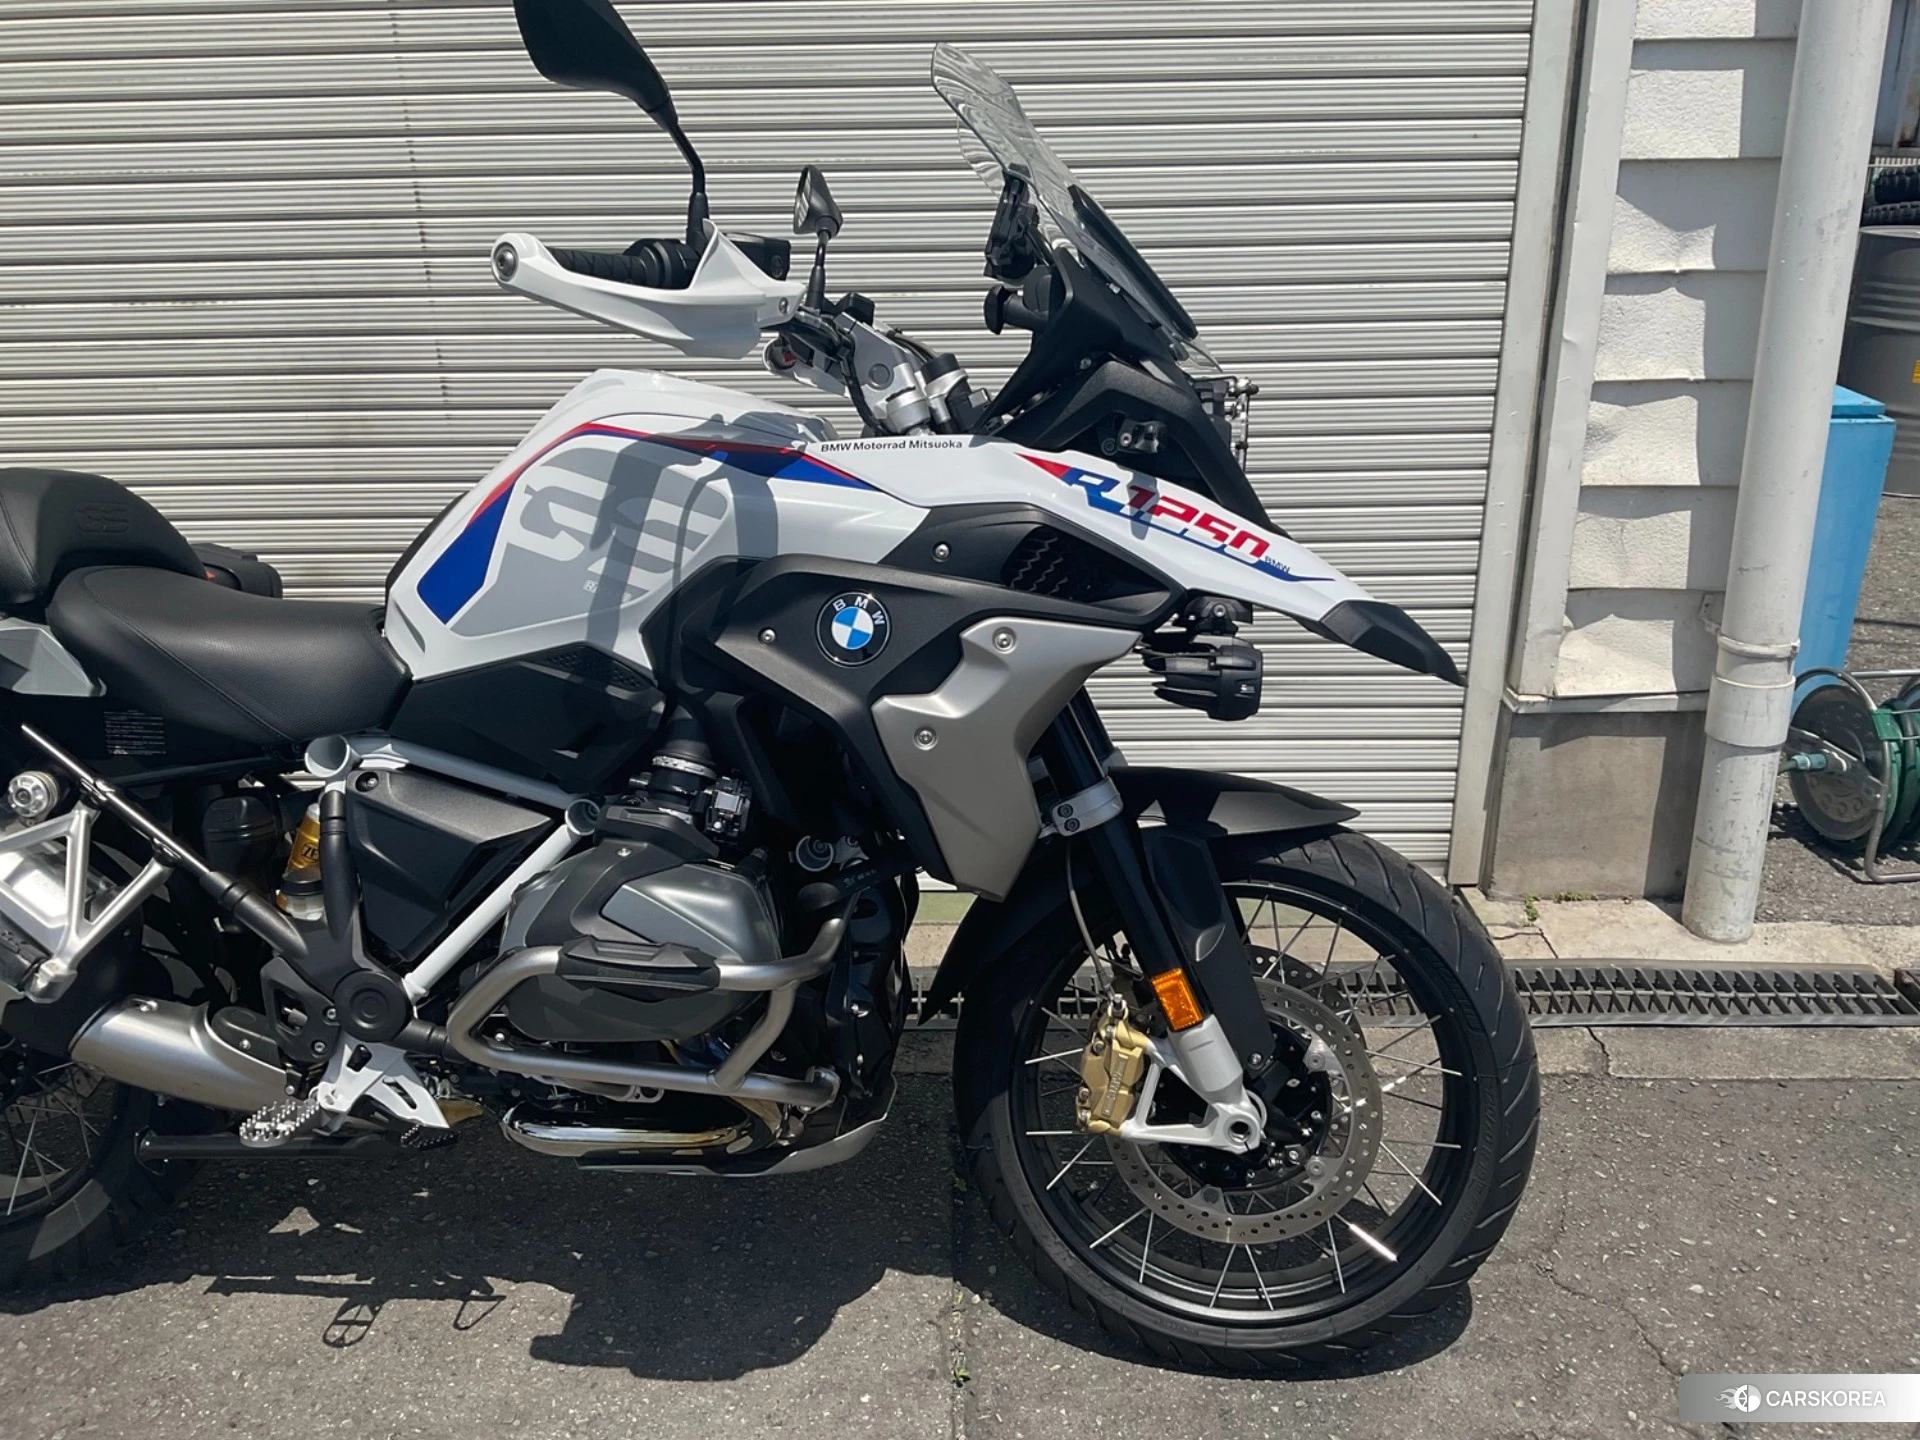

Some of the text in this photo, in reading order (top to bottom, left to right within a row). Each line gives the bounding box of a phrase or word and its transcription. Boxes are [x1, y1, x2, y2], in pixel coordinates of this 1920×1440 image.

[820, 439, 963, 453] BMW Motorrad Mitsuoka
[832, 596, 886, 626] BMW
